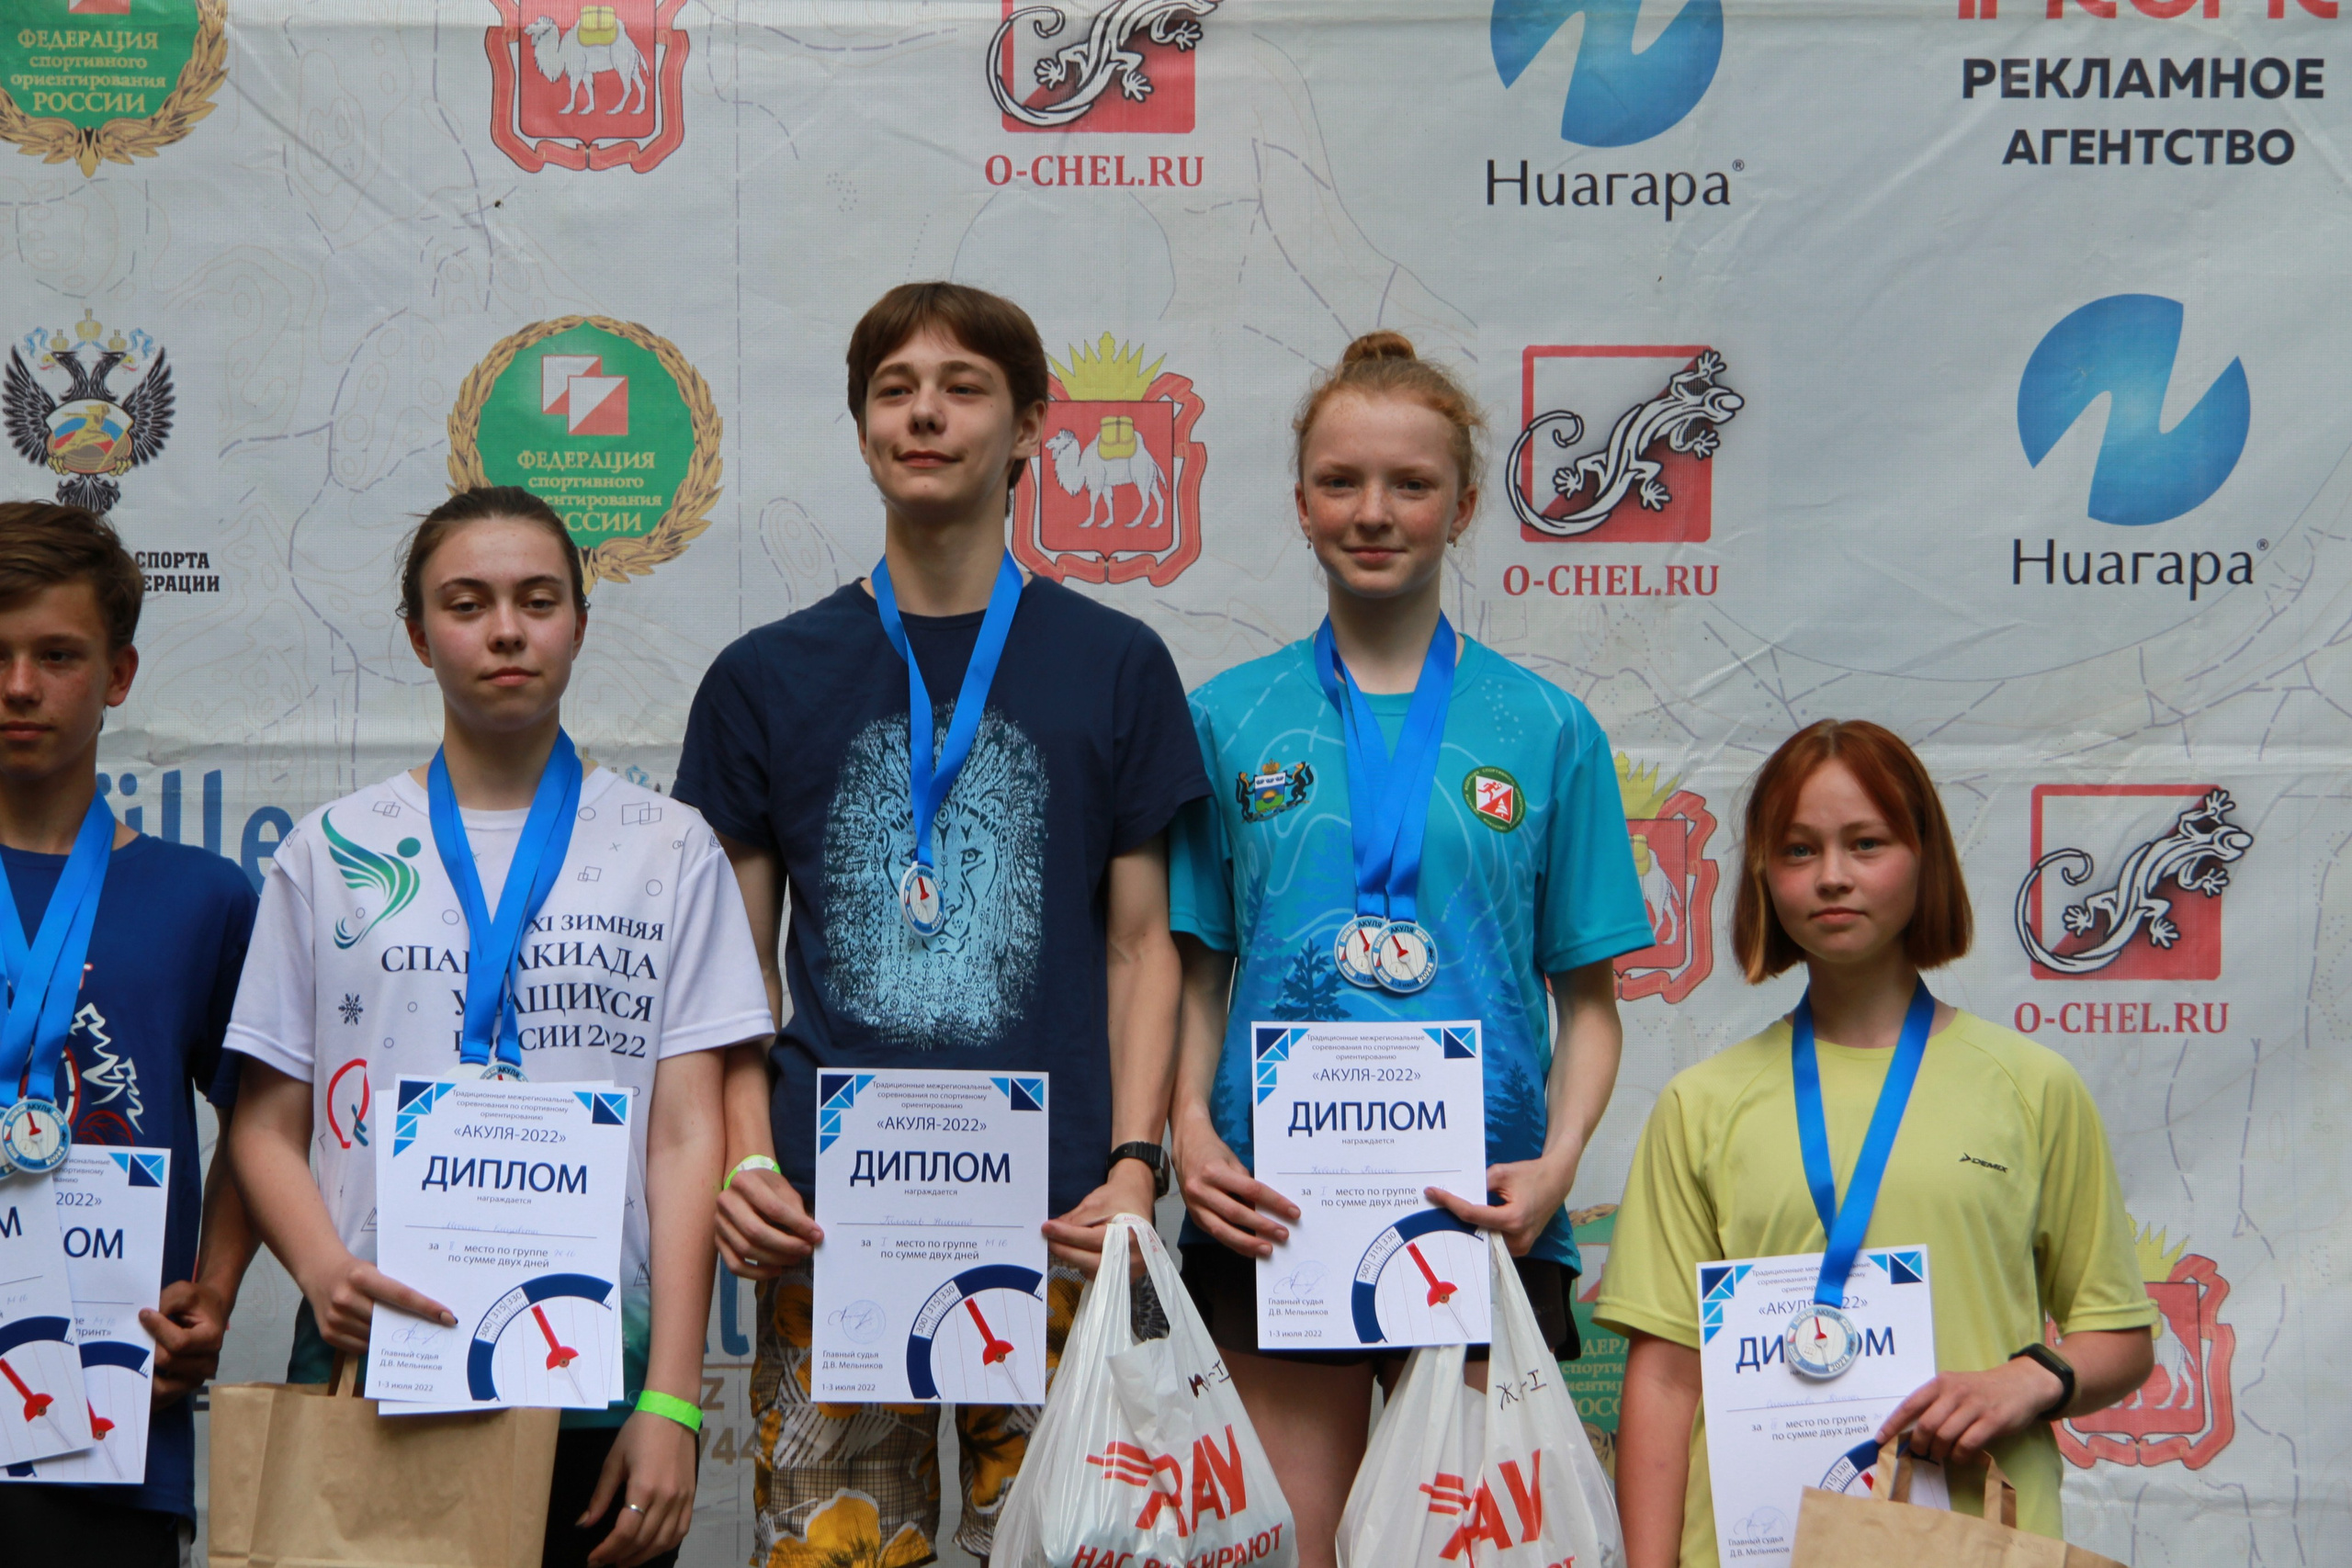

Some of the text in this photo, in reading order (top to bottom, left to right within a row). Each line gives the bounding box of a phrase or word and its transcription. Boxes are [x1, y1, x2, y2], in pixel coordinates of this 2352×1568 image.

[17, 28, 159, 53] ФЕДЕРАЦИЯ
[29, 55, 148, 72] спортивного
[10, 73, 166, 90] ориентирования
[1962, 57, 2324, 99] РЕКЛАМНОЕ
[33, 91, 145, 113] РОССИИ
[2001, 129, 2295, 165] АГЕНТСТВО
[985, 154, 1204, 187] O-CHEL.RU
[517, 450, 655, 473] ФЕДЕРАЦИЯ
[528, 477, 644, 492] спортивного
[561, 512, 642, 532] ССИИ
[134, 551, 209, 569] СПОРТА
[143, 575, 220, 594] ЕРАЦИИ
[1503, 563, 1719, 598] O-CHEL.RU
[560, 914, 665, 942] ЗИМНЯЯ
[1390, 925, 1415, 933] АКУЛЯ
[2014, 1000, 2230, 1036] O-CHEL.RU
[1306, 1033, 1425, 1043] Традиционные межрегиональные
[1312, 1044, 1362, 1053] соревнования
[1374, 1044, 1419, 1053] спортивному
[1312, 1067, 1421, 1082] «АКУЛЯ-2022»
[872, 1080, 992, 1091] Традиционные межрегиональные
[452, 1089, 574, 1105] Традиционные межрегиональные
[877, 1091, 928, 1100] соревнования
[940, 1092, 987, 1101] спортивному
[457, 1100, 508, 1109] соревнования
[521, 1104, 568, 1114] спортивному
[901, 1101, 963, 1110] ориентированию
[481, 1111, 543, 1121] ориентированию
[1288, 1100, 1446, 1137] ДИПЛОМ
[876, 1116, 987, 1132] «АКУЛЯ-2022»
[454, 1124, 566, 1144] «АКУЛЯ-2022»
[422, 1156, 587, 1194] ДИПЛОМ
[850, 1150, 1011, 1187] ДИПЛОМ
[904, 1188, 957, 1196] награждается
[1335, 1188, 1364, 1196] место
[1382, 1188, 1417, 1198] группе
[477, 1195, 531, 1205] награждается
[1336, 1199, 1367, 1207] сумме
[1369, 1198, 1392, 1207] двух
[1394, 1197, 1419, 1207] дней
[464, 1246, 494, 1255] место
[513, 1247, 548, 1258] группе
[896, 1240, 926, 1248] место
[943, 1241, 978, 1250] группе
[896, 1252, 927, 1260] сумме
[929, 1251, 952, 1260] двух
[954, 1250, 979, 1260] дней
[1359, 1231, 1396, 1280] 300 315 330
[463, 1256, 495, 1265] сумме
[497, 1258, 521, 1269] двух
[524, 1258, 549, 1268] дней
[1752, 1266, 1804, 1277] Традиционные
[1758, 1276, 1808, 1286] соревнования
[1268, 1297, 1300, 1305] Главный
[479, 1292, 523, 1337] 300 315 330
[915, 1285, 956, 1334] 300 315 330
[1268, 1308, 1283, 1316] Д.В.
[380, 1348, 439, 1360] Главный судья
[822, 1350, 855, 1359] Главный
[379, 1359, 443, 1371] Д.В. Мельников
[822, 1361, 883, 1370] Д.В. Мельников
[378, 1381, 390, 1389] 1-3
[1785, 1420, 1815, 1429] место
[1832, 1415, 1867, 1426] группе
[1786, 1430, 1818, 1440] сумме
[1820, 1427, 1842, 1438] двух
[1844, 1425, 1869, 1436] дней
